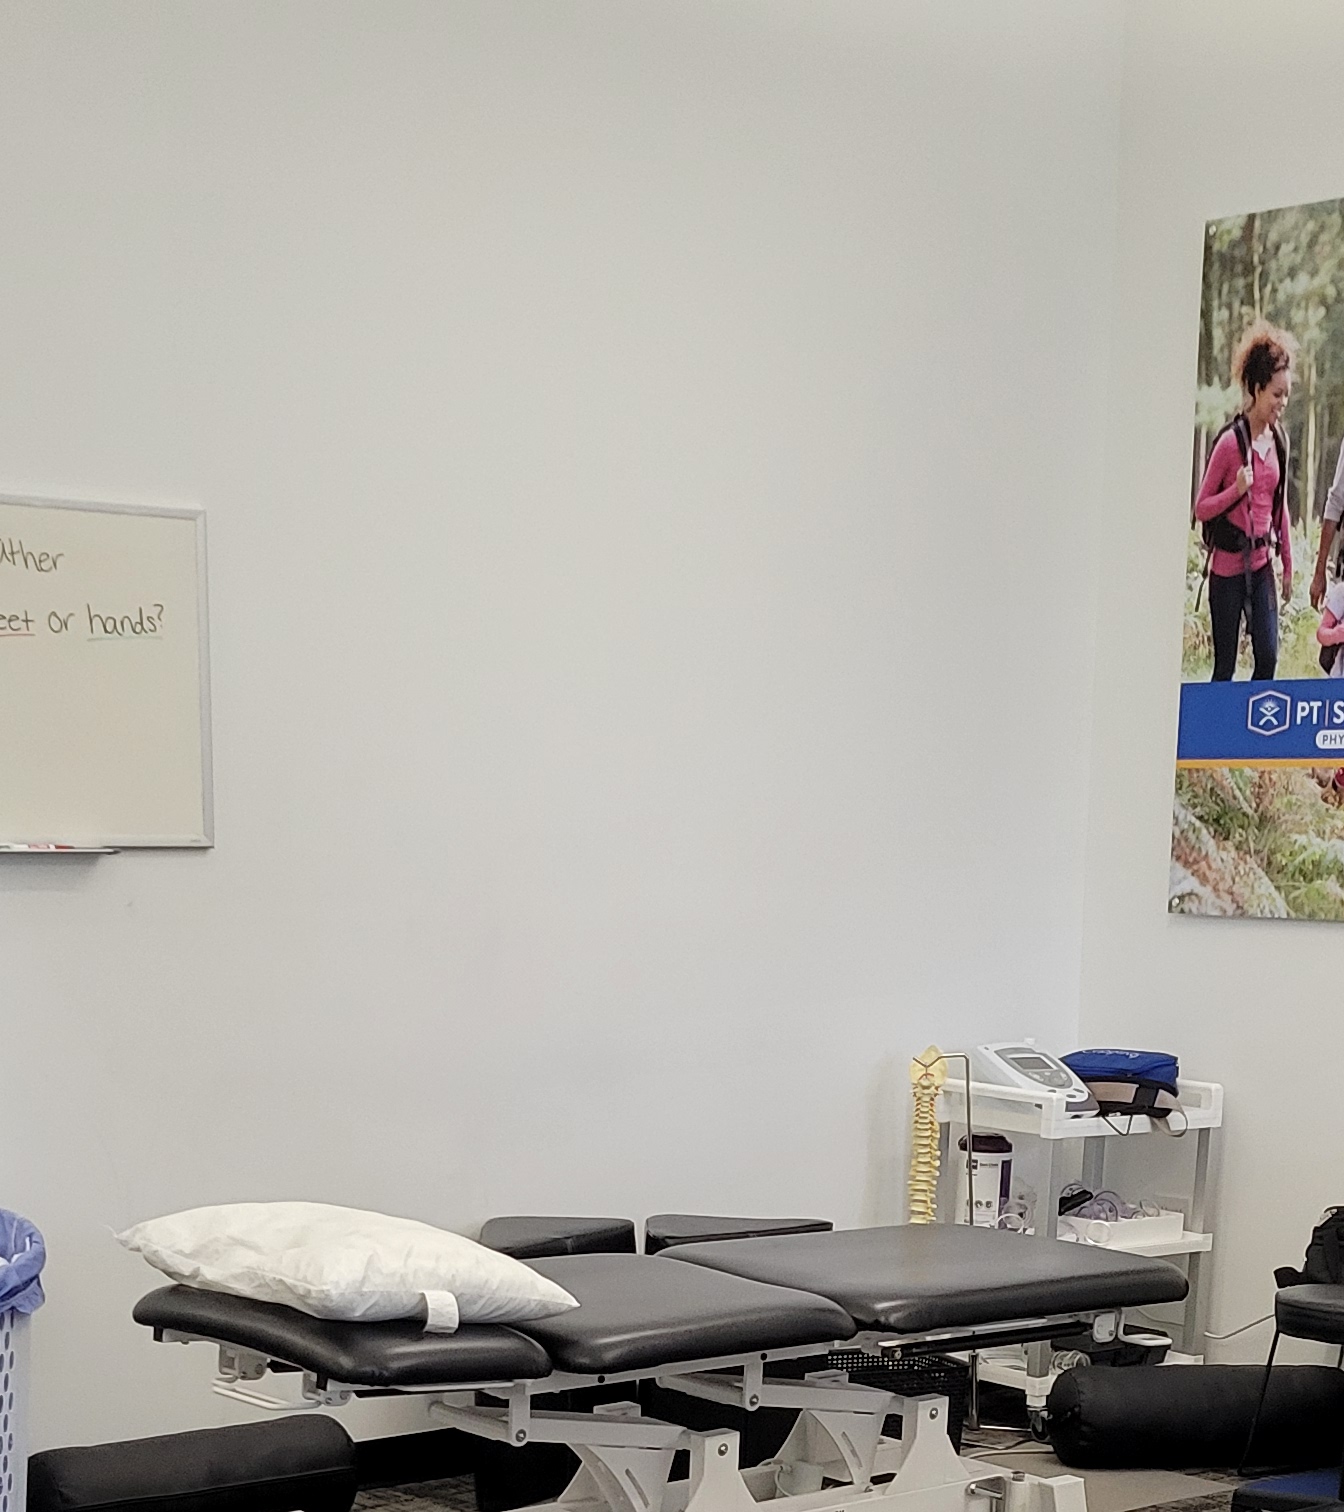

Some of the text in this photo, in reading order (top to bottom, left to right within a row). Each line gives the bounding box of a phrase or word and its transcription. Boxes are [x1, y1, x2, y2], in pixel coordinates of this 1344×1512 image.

[48, 610, 75, 634] or
[86, 602, 165, 637] hands?
[1296, 700, 1322, 725] PT
